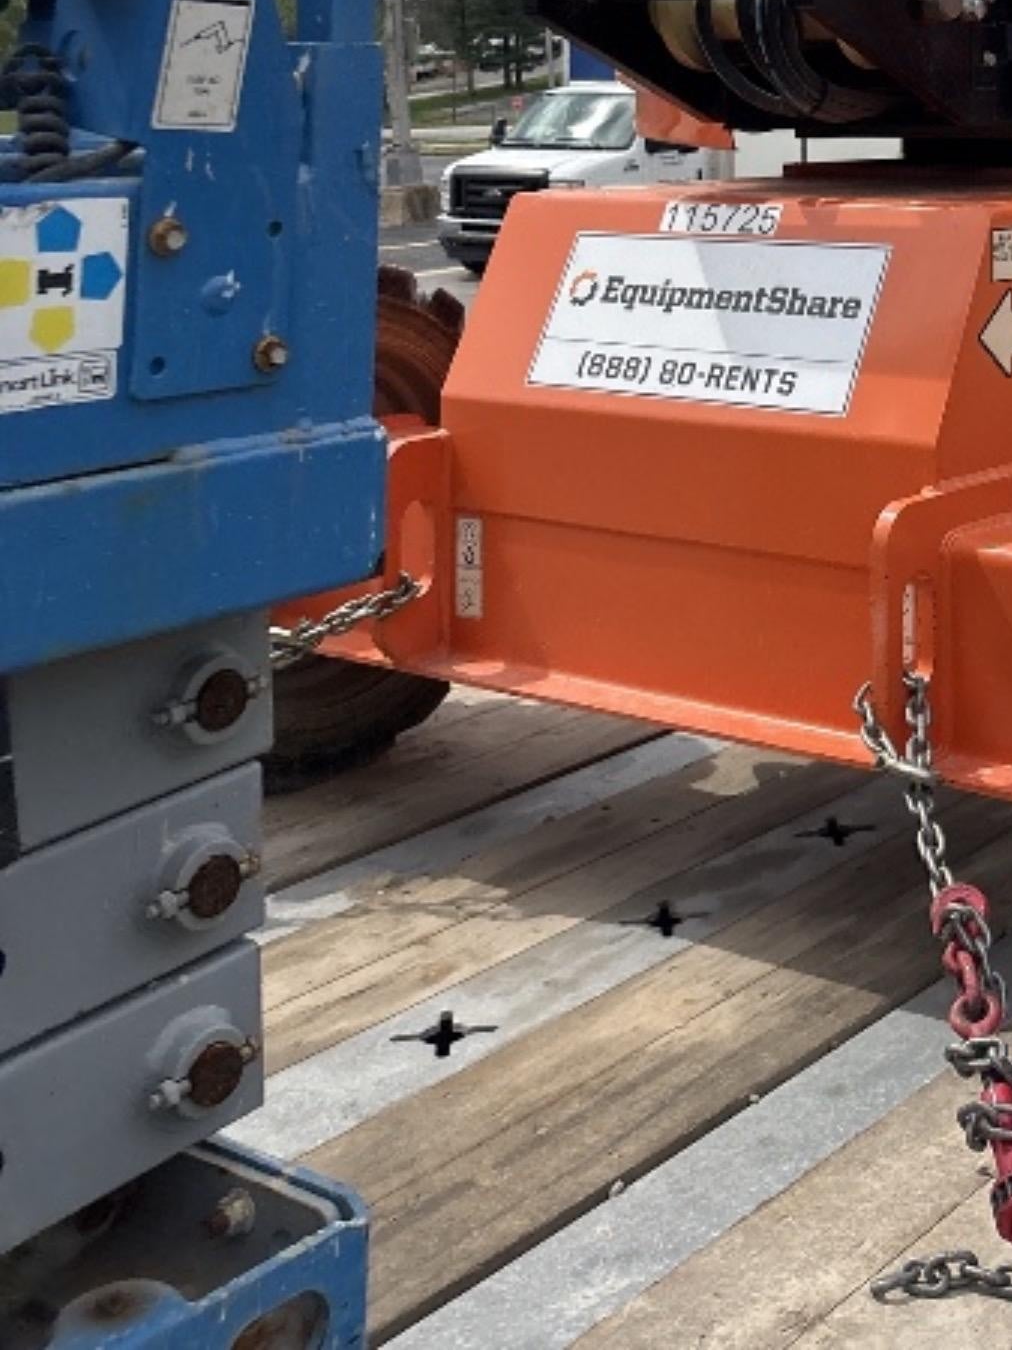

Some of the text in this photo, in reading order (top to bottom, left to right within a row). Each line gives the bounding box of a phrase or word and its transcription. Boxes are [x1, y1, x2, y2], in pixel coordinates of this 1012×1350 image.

[667, 203, 780, 235] 115725
[600, 275, 863, 319] EquipmentShare
[576, 350, 798, 397] (888) 80-RENTS
